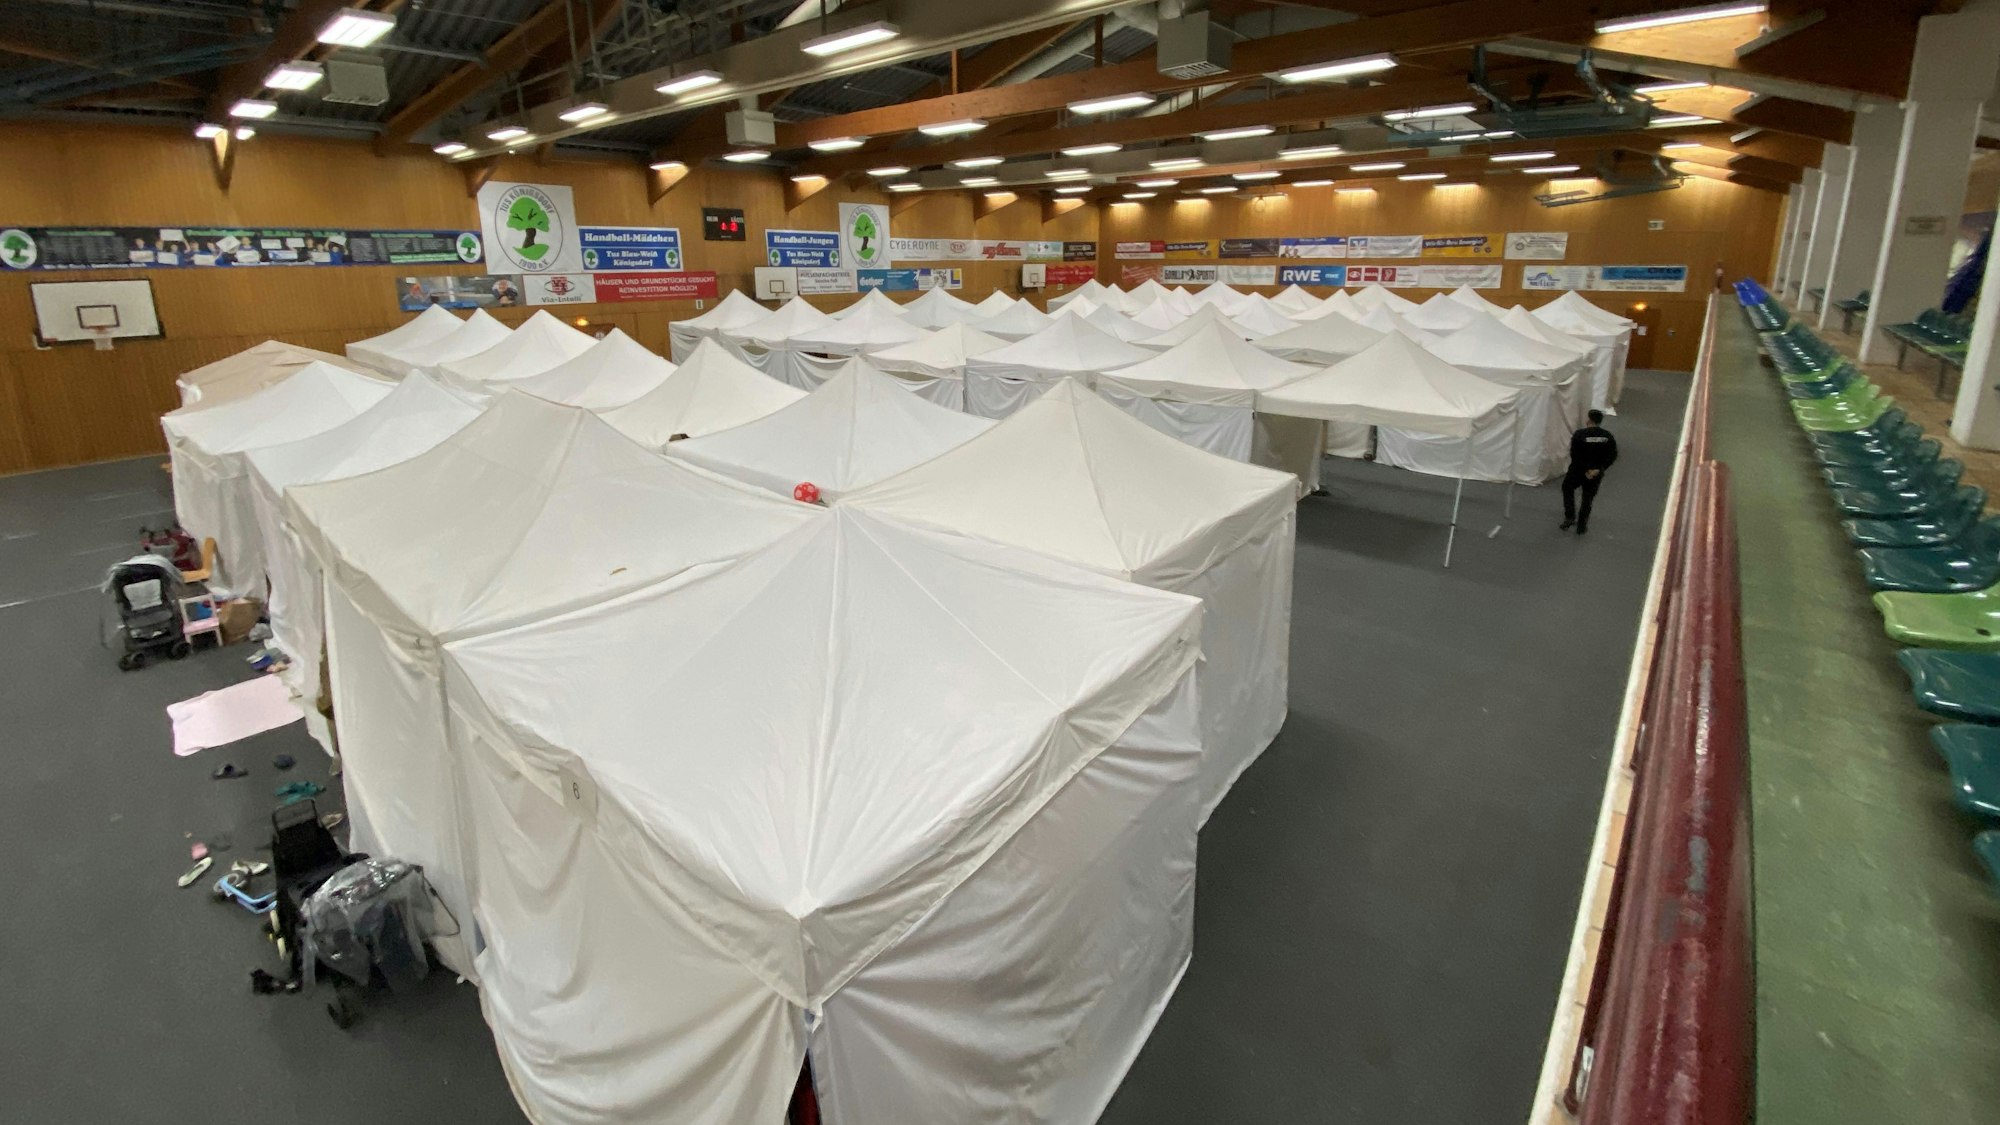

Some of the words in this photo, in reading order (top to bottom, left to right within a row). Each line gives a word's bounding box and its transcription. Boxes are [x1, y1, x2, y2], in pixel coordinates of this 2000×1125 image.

[584, 232, 674, 242] Handball-Mädchen
[773, 235, 834, 245] Handball-Jungen
[889, 240, 940, 250] CYBERDYNE
[613, 259, 653, 267] Königsdorf
[641, 276, 686, 284] GRUNDSTÜCKE
[1283, 269, 1321, 281] RWE
[572, 782, 580, 800] 6
